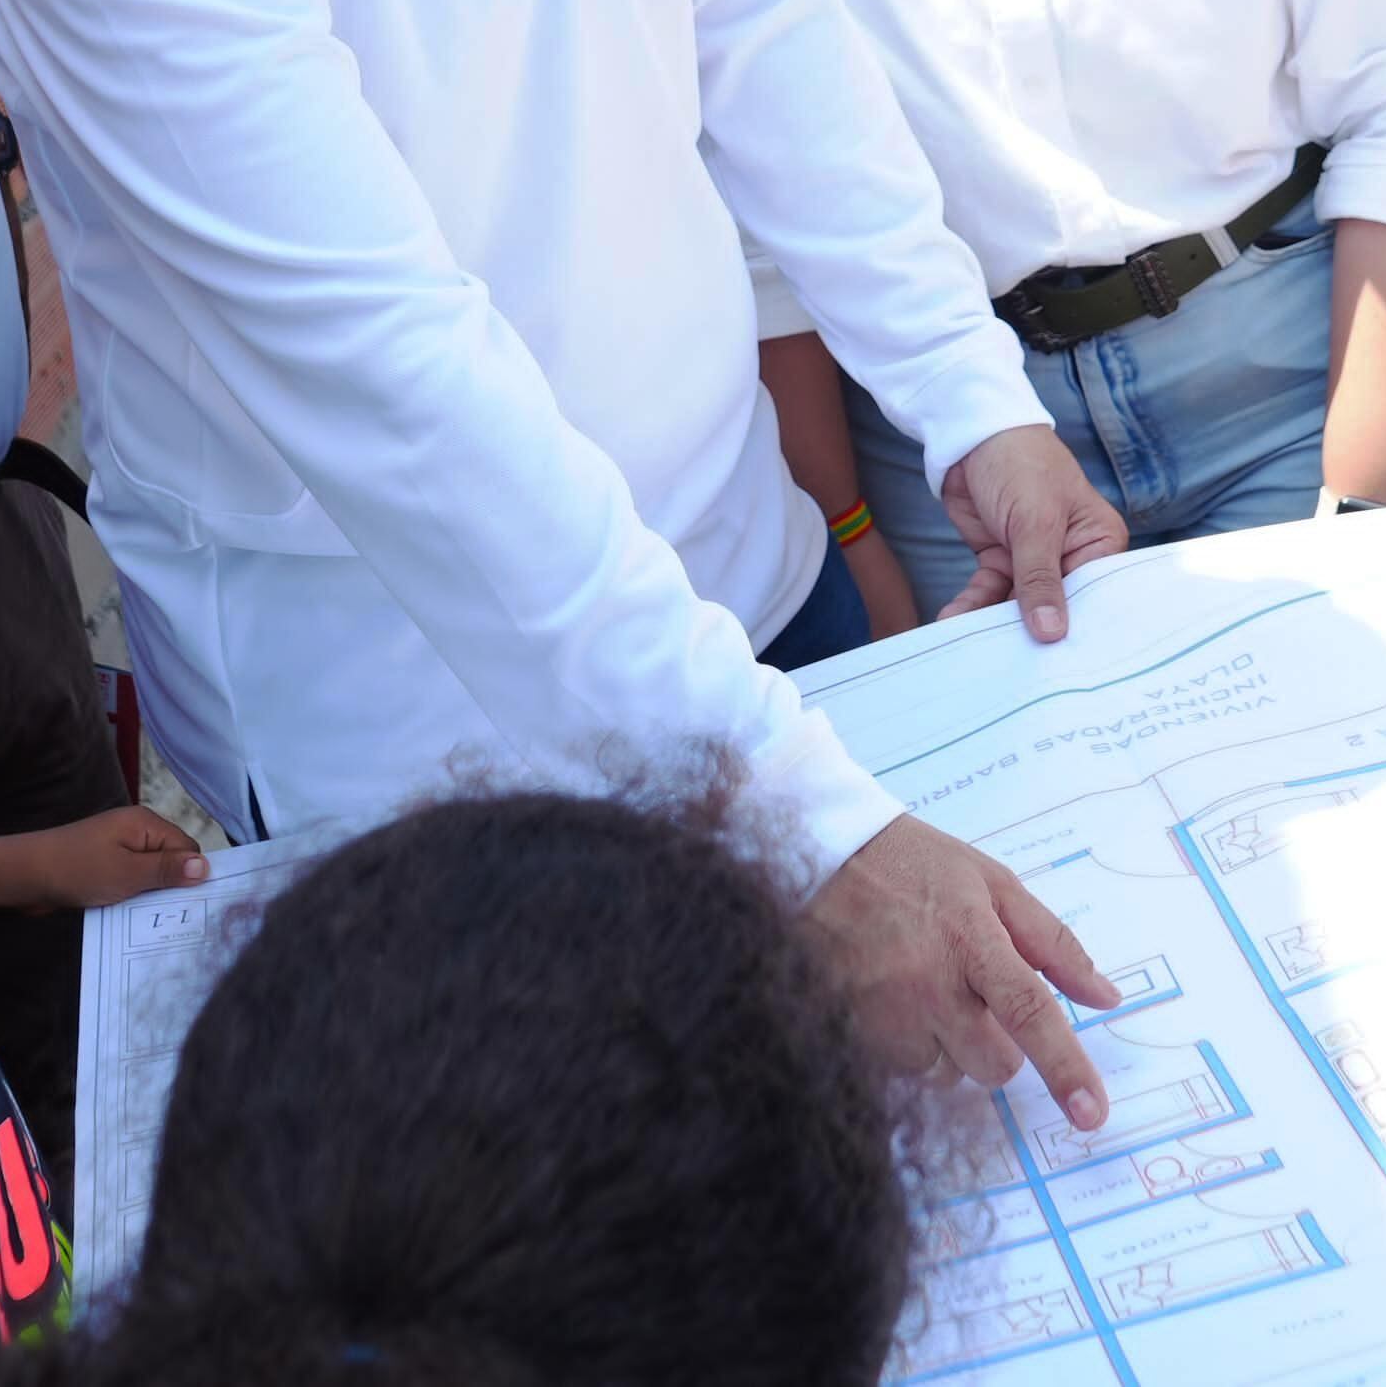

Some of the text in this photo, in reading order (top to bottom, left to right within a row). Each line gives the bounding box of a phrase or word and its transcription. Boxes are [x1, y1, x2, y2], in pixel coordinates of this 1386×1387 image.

[1144, 653, 1255, 699] OLAYA
[1034, 673, 1267, 753] INCINERADAS
[1089, 696, 1276, 755] VIVIENDAS
